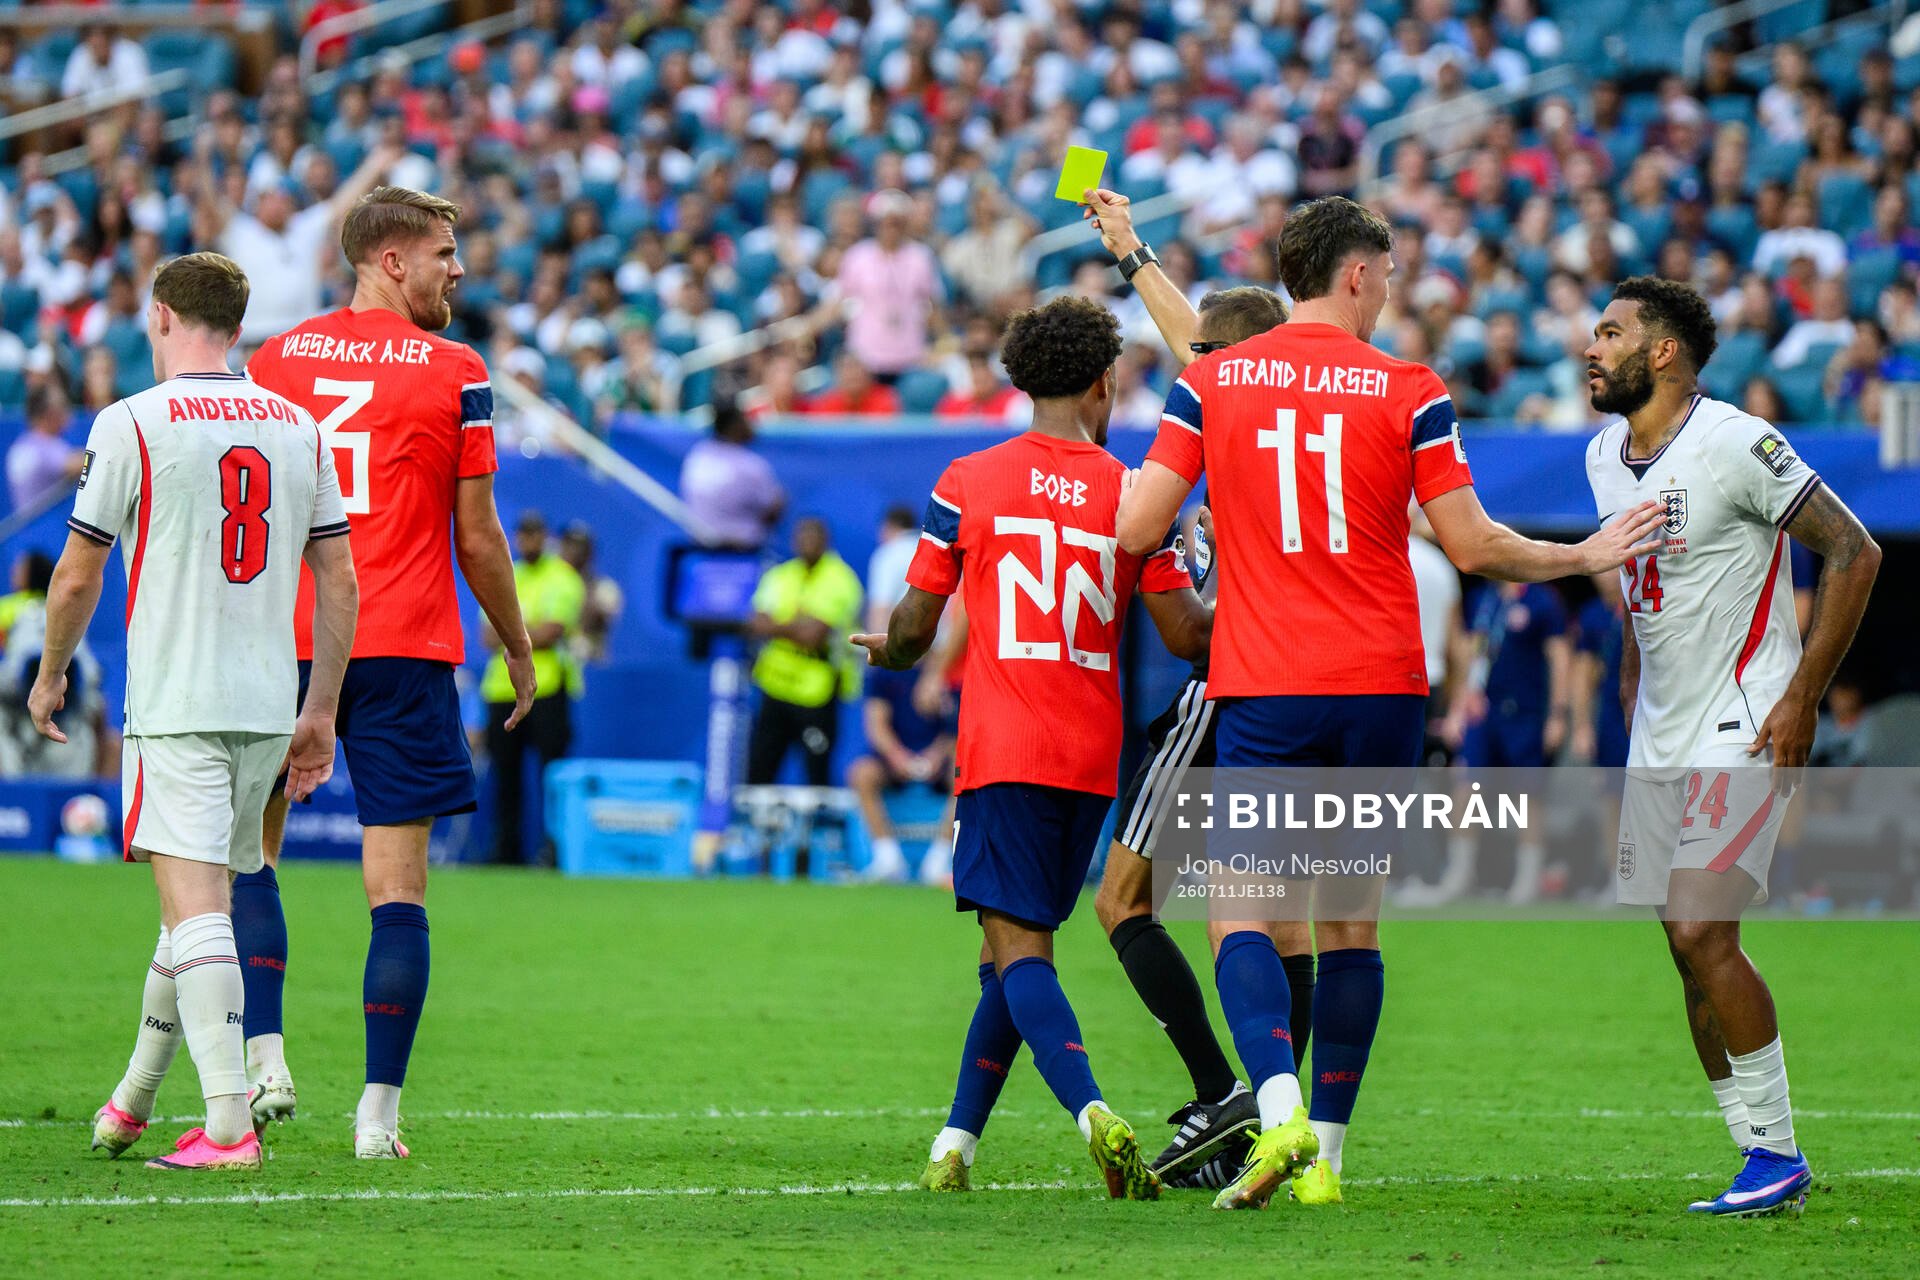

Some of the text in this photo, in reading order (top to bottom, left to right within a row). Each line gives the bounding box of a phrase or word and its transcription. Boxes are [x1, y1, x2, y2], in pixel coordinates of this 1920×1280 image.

[282, 333, 433, 365] VASSBAKK AJER
[1217, 358, 1389, 398] STRAND LARSEN
[168, 397, 299, 426] ANDERSON
[313, 377, 375, 514] 3
[1031, 467, 1088, 507] BOBB
[1257, 408, 1350, 554] 11
[218, 445, 271, 584] 8
[994, 515, 1118, 672] 22
[1624, 554, 1664, 613] 24
[1681, 771, 1731, 829] 24
[145, 1016, 174, 1033] ENG
